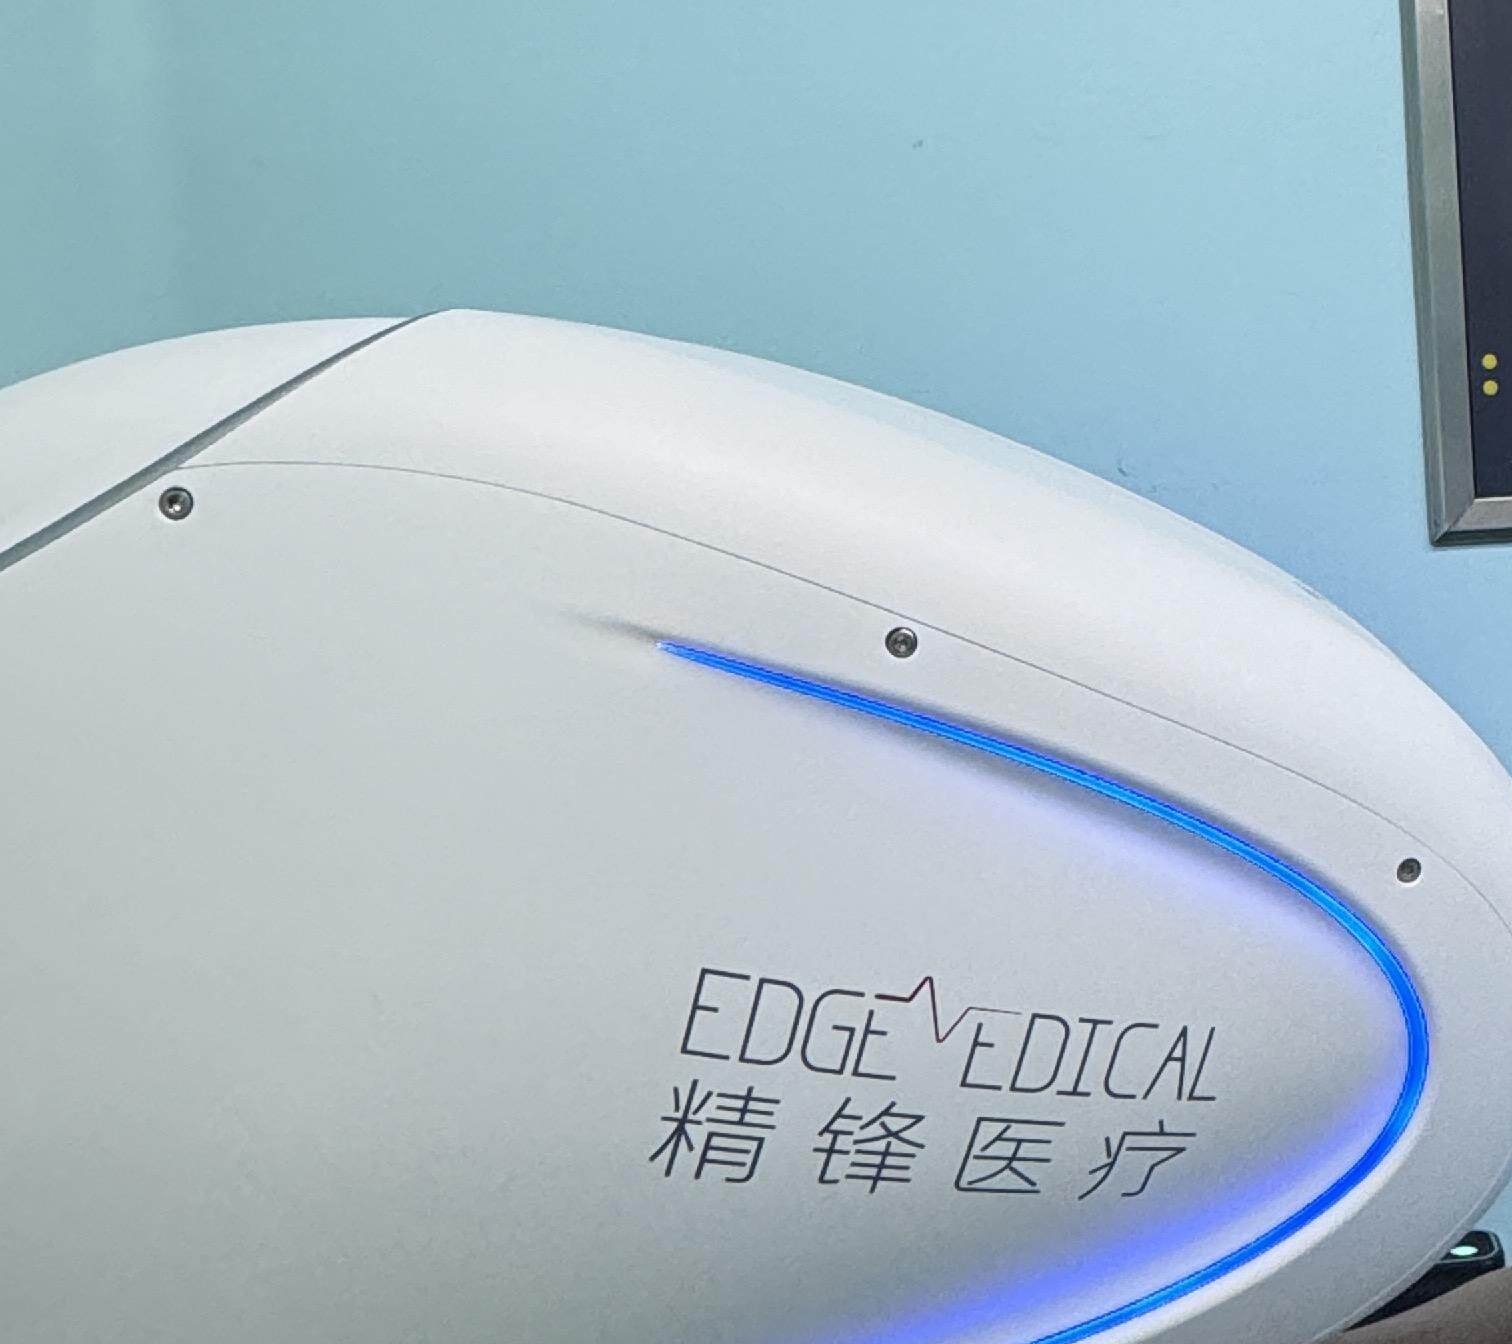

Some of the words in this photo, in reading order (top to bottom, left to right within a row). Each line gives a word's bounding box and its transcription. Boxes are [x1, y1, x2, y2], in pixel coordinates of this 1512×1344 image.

[681, 968, 897, 1081] EDGE
[649, 1079, 1197, 1201] 精锋医疗
